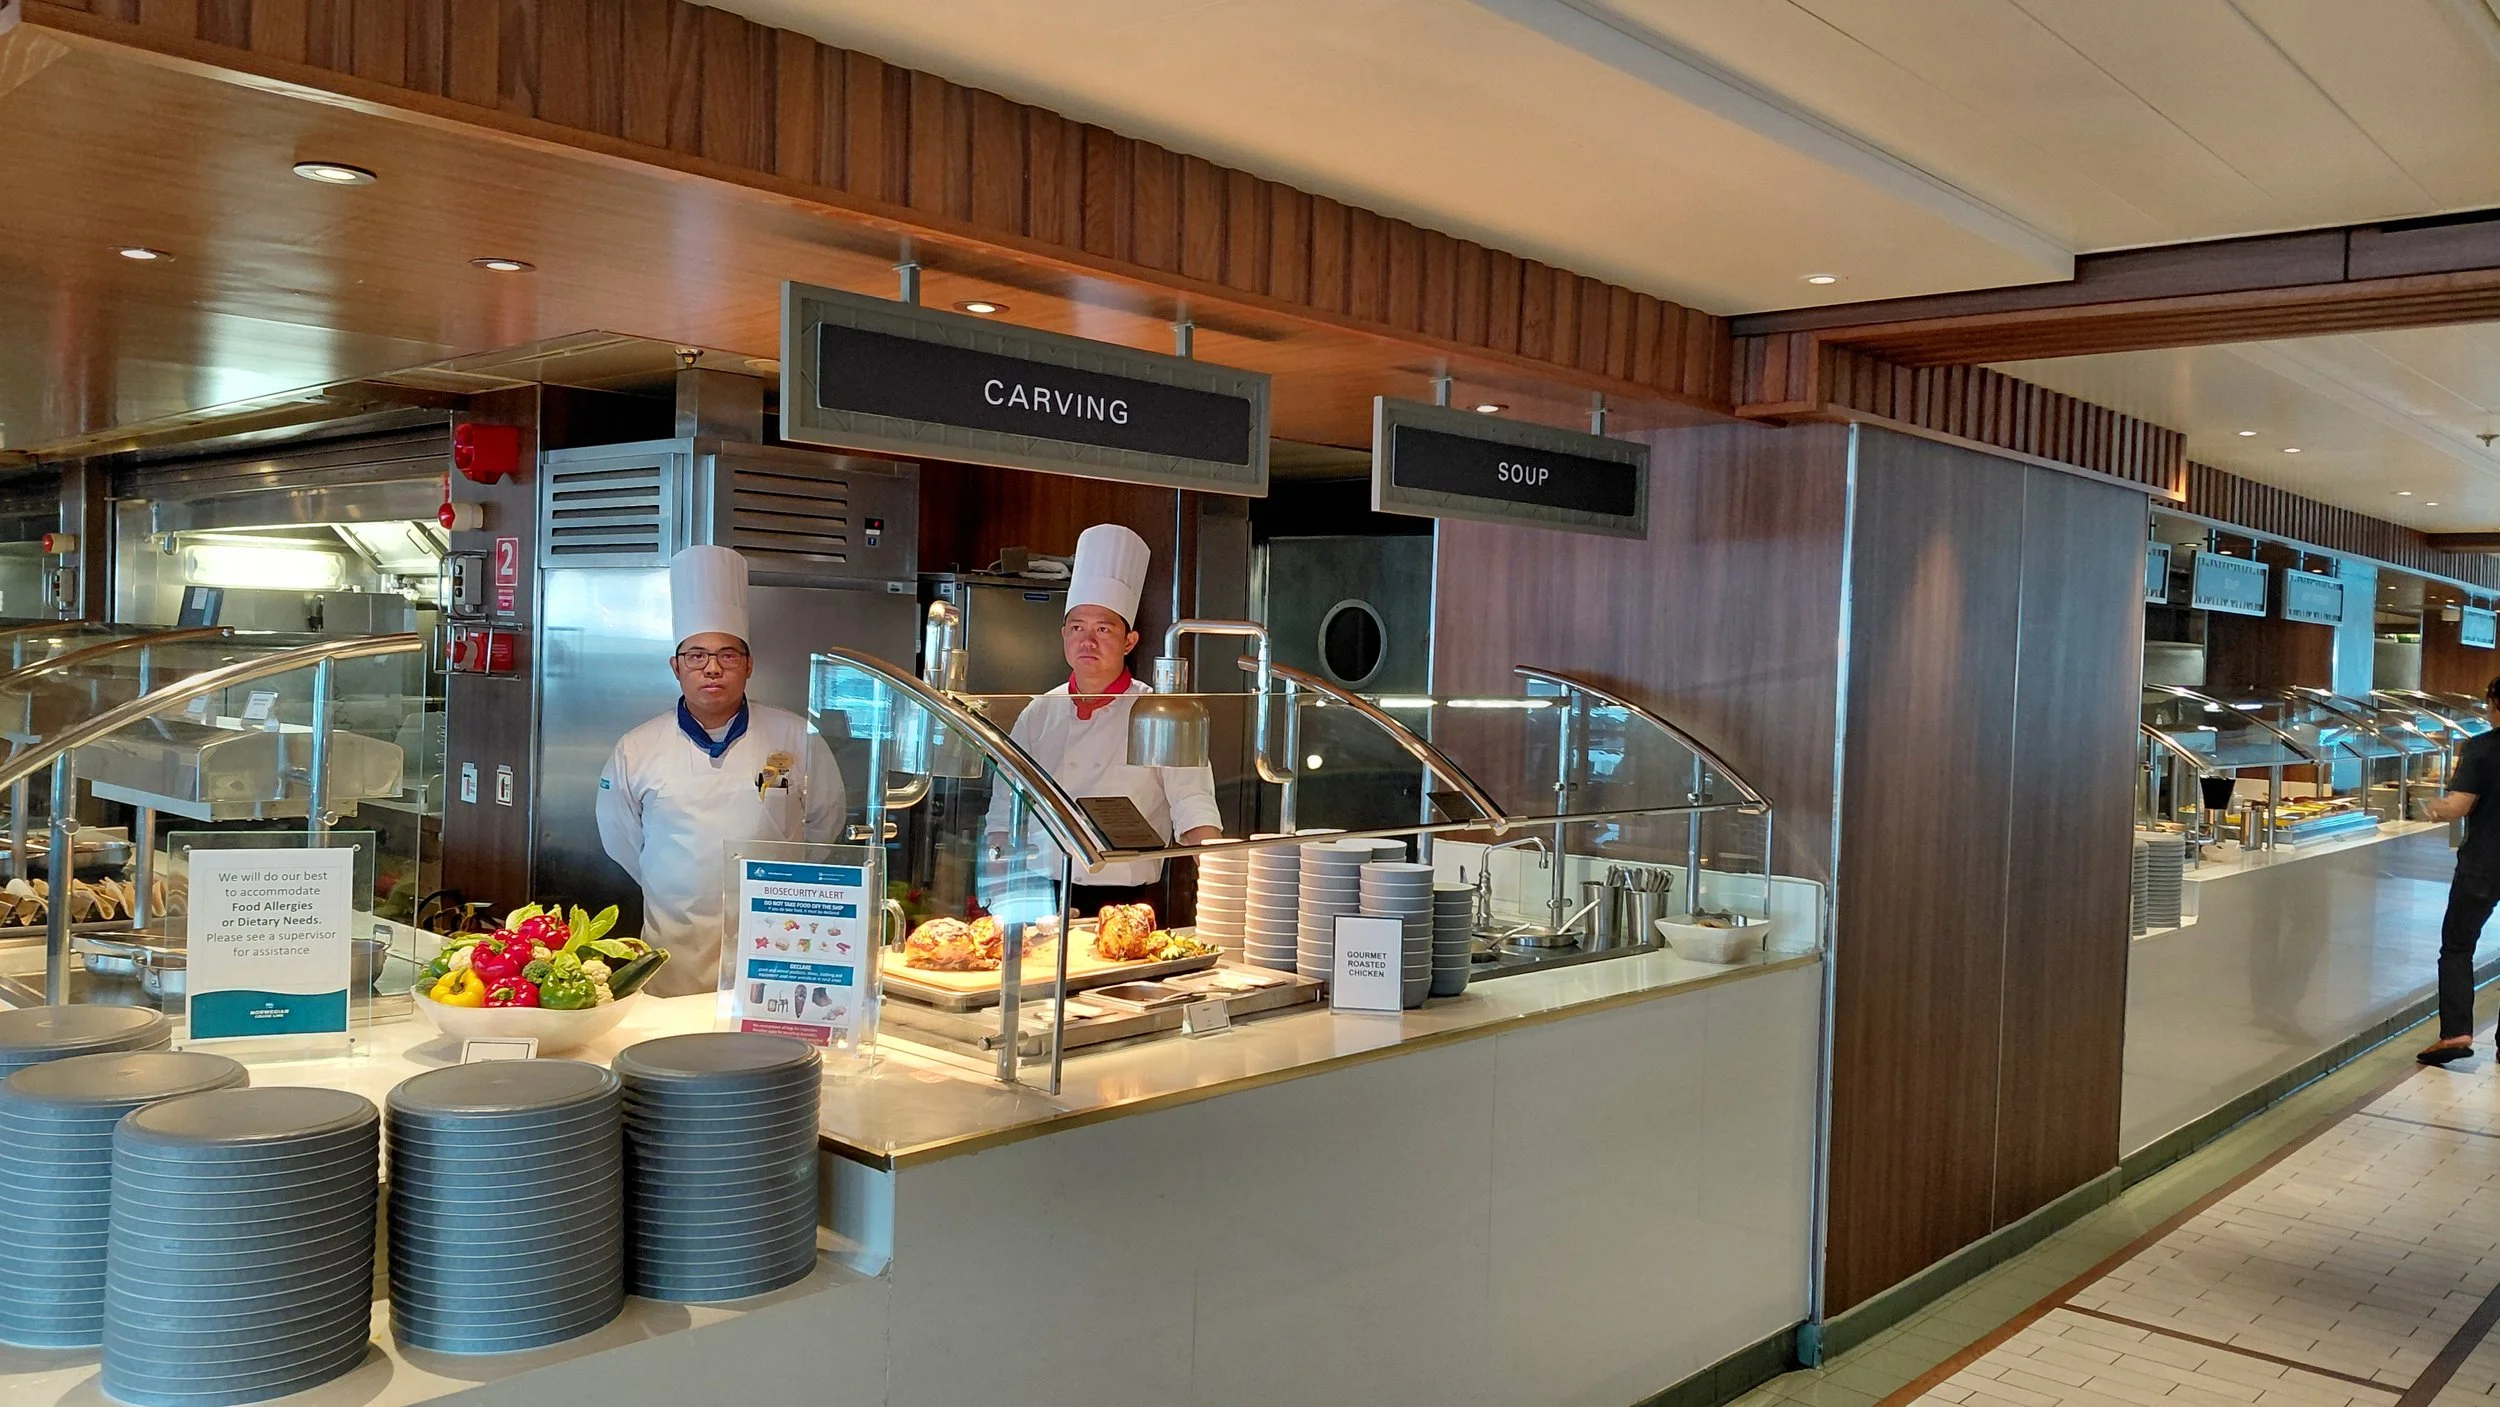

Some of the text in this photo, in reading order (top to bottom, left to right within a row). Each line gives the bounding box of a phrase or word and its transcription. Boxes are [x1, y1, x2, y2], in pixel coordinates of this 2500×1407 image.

[984, 379, 1128, 424] CARVING
[1498, 462, 1549, 486] SOUP
[501, 543, 513, 575] 2
[218, 871, 328, 882] We will do our best
[225, 886, 320, 897] to accommodate
[764, 886, 845, 900] BIOSECURITY ALERT
[232, 901, 313, 912] Food Allergies
[222, 916, 322, 927] or Dietary Needs.
[207, 933, 243, 942] Please
[246, 933, 265, 941] see
[279, 931, 336, 942] supervisor
[233, 947, 310, 956] for assistance
[1347, 951, 1387, 959] GOURMET
[1348, 960, 1386, 968] ROASTED
[1349, 969, 1384, 977] CHICKEN
